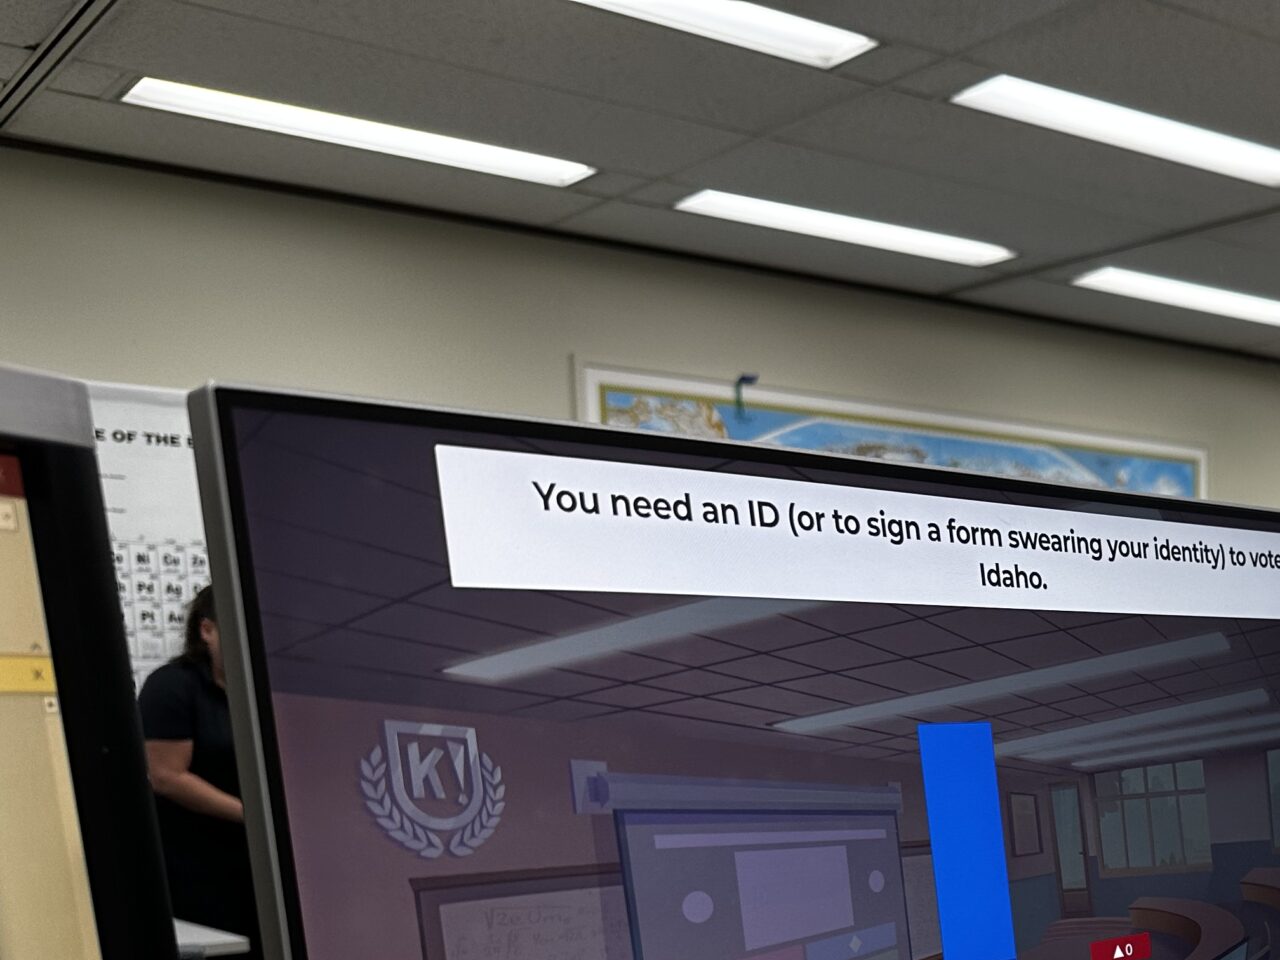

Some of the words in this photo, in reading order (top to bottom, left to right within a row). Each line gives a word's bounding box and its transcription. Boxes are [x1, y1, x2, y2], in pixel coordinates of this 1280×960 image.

[112, 430, 137, 444] OF
[143, 431, 181, 449] THE
[531, 481, 600, 514] You
[610, 493, 693, 521] need
[702, 502, 739, 525] an
[748, 500, 780, 528] ID
[788, 503, 825, 537] (or
[832, 509, 861, 534] to
[867, 510, 921, 545] sign
[927, 523, 942, 542] a
[946, 518, 1003, 548] form
[1008, 529, 1102, 560] swearing
[1106, 543, 1150, 564] your
[1154, 537, 1226, 570] identity)
[1229, 546, 1247, 567] to
[979, 563, 1048, 590] Idaho.
[1125, 943, 1133, 956] 0
